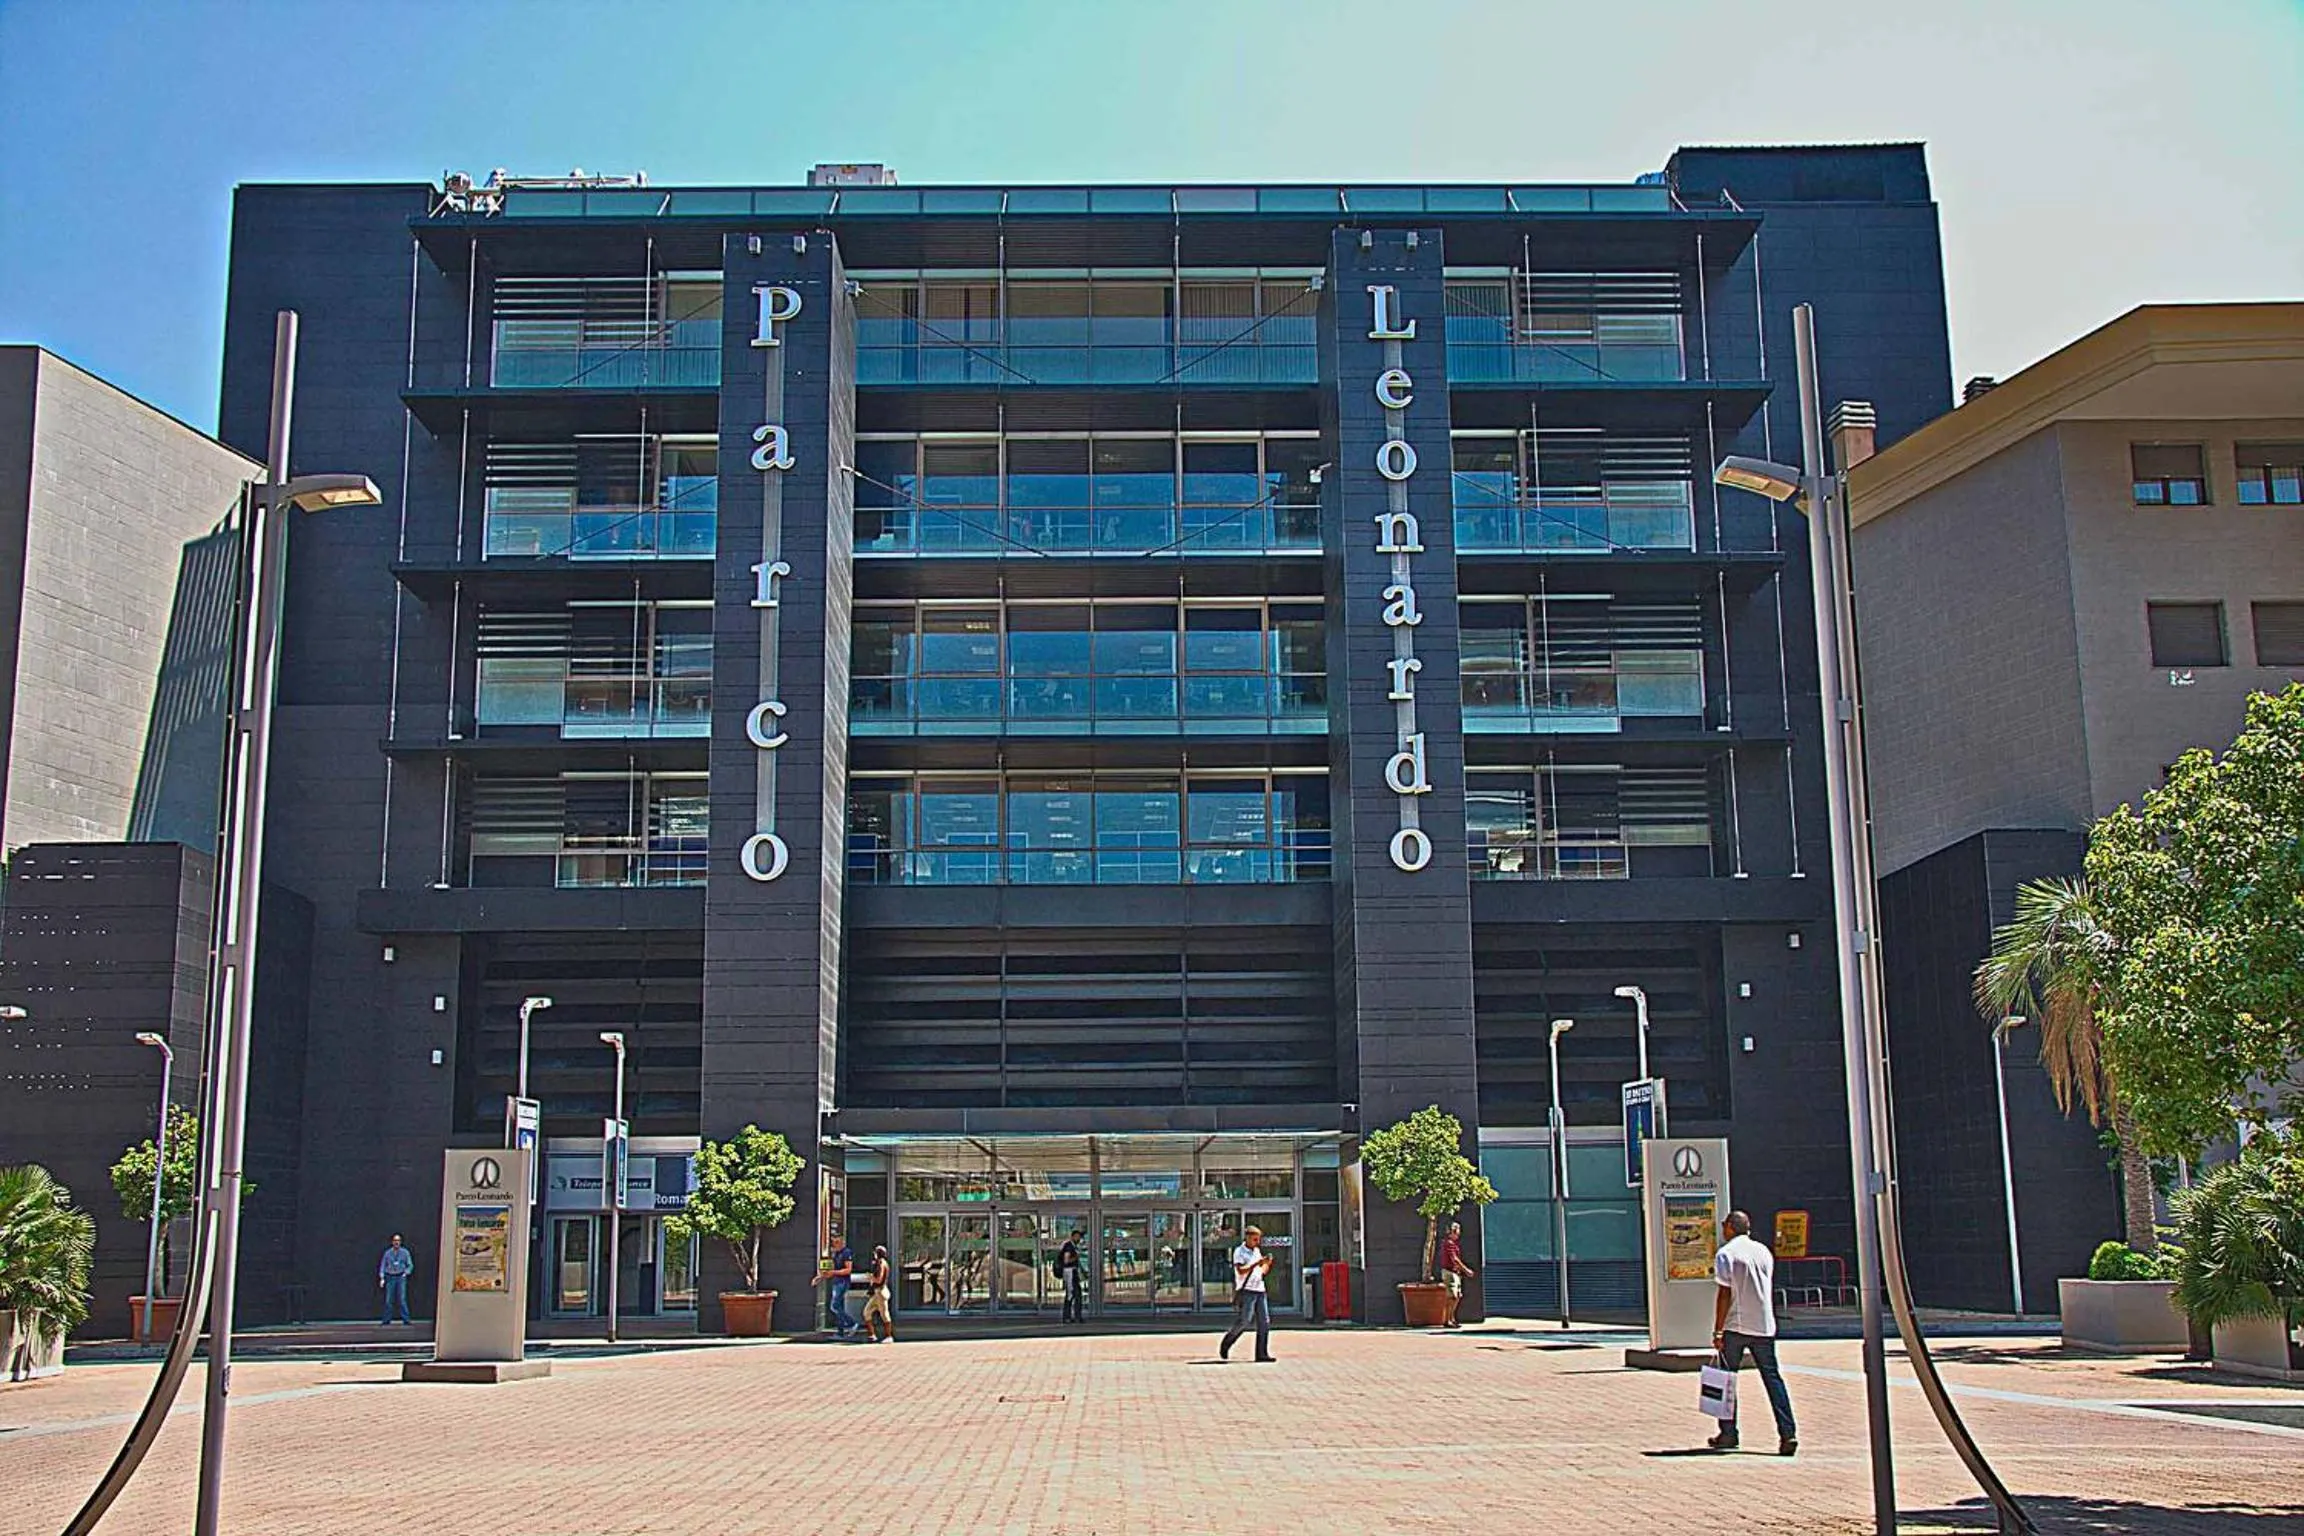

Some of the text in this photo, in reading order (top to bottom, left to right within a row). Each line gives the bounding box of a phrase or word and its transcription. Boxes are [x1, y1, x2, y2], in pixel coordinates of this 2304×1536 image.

[740, 286, 803, 881] Parco
[1366, 284, 1433, 872] Leonardo
[455, 1191, 514, 1201] Parco Leonardo
